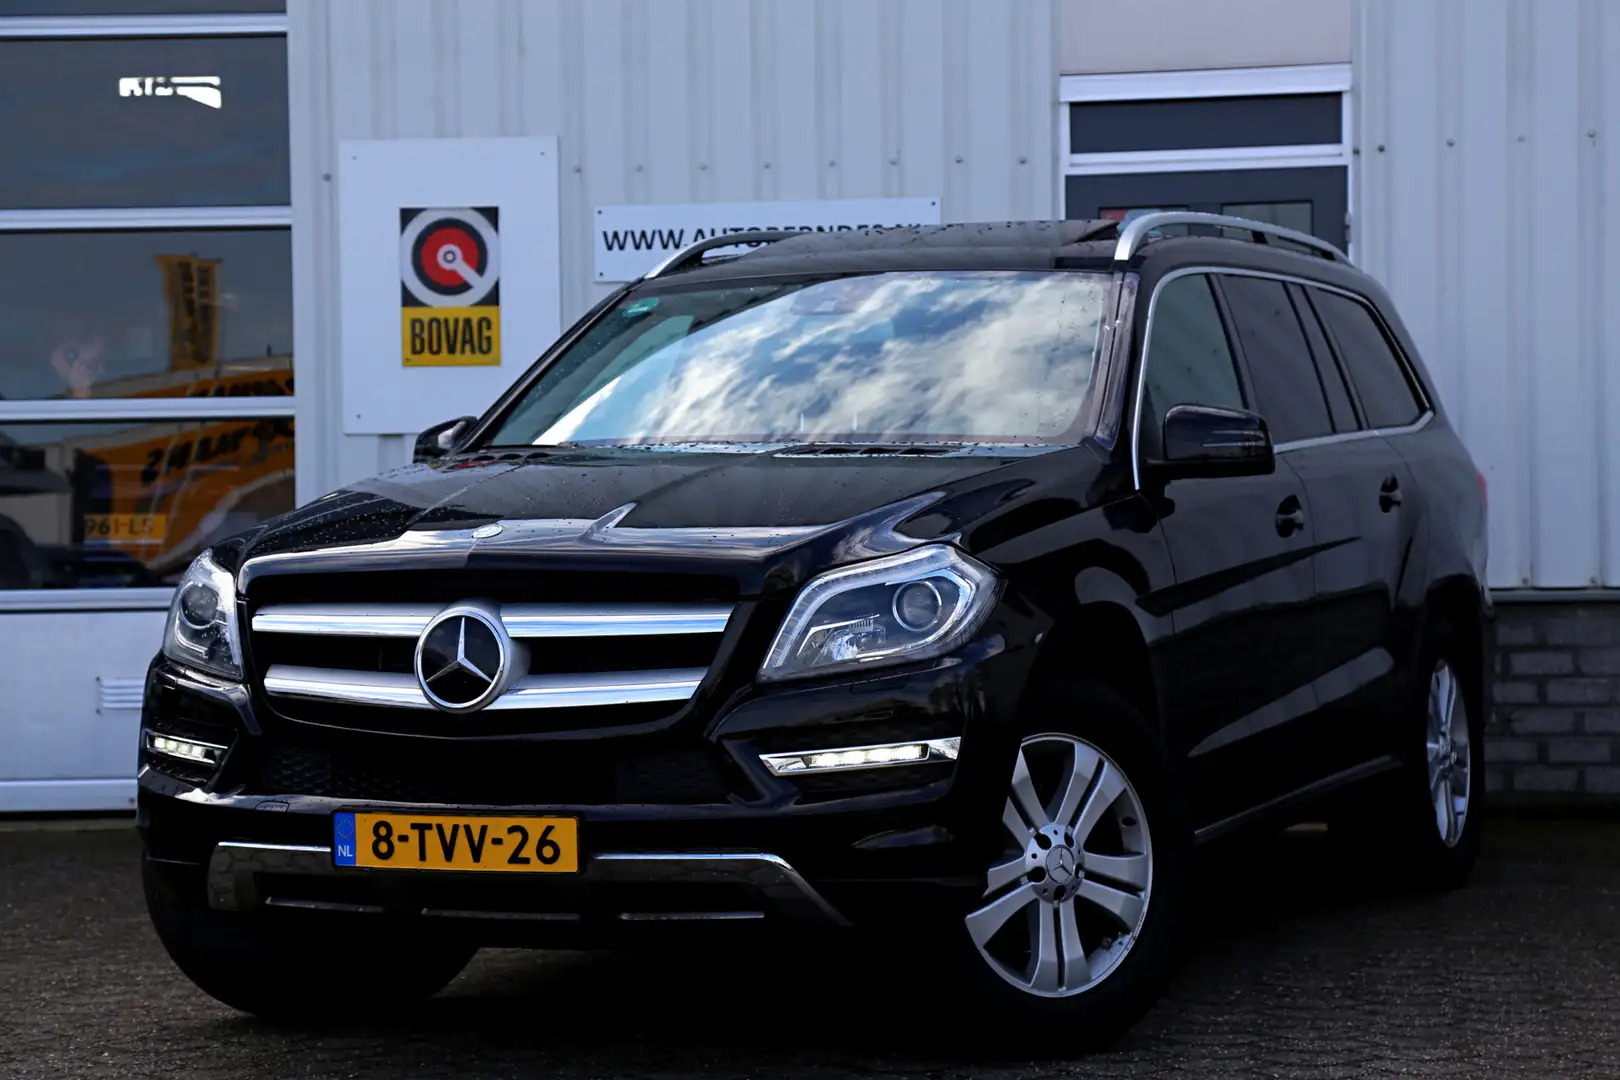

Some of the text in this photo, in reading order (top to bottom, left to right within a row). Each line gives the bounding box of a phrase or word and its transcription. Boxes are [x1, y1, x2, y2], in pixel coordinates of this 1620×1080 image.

[411, 316, 492, 355] BOVAG
[337, 844, 353, 857] NL
[371, 820, 561, 865] 8-TVV-26
